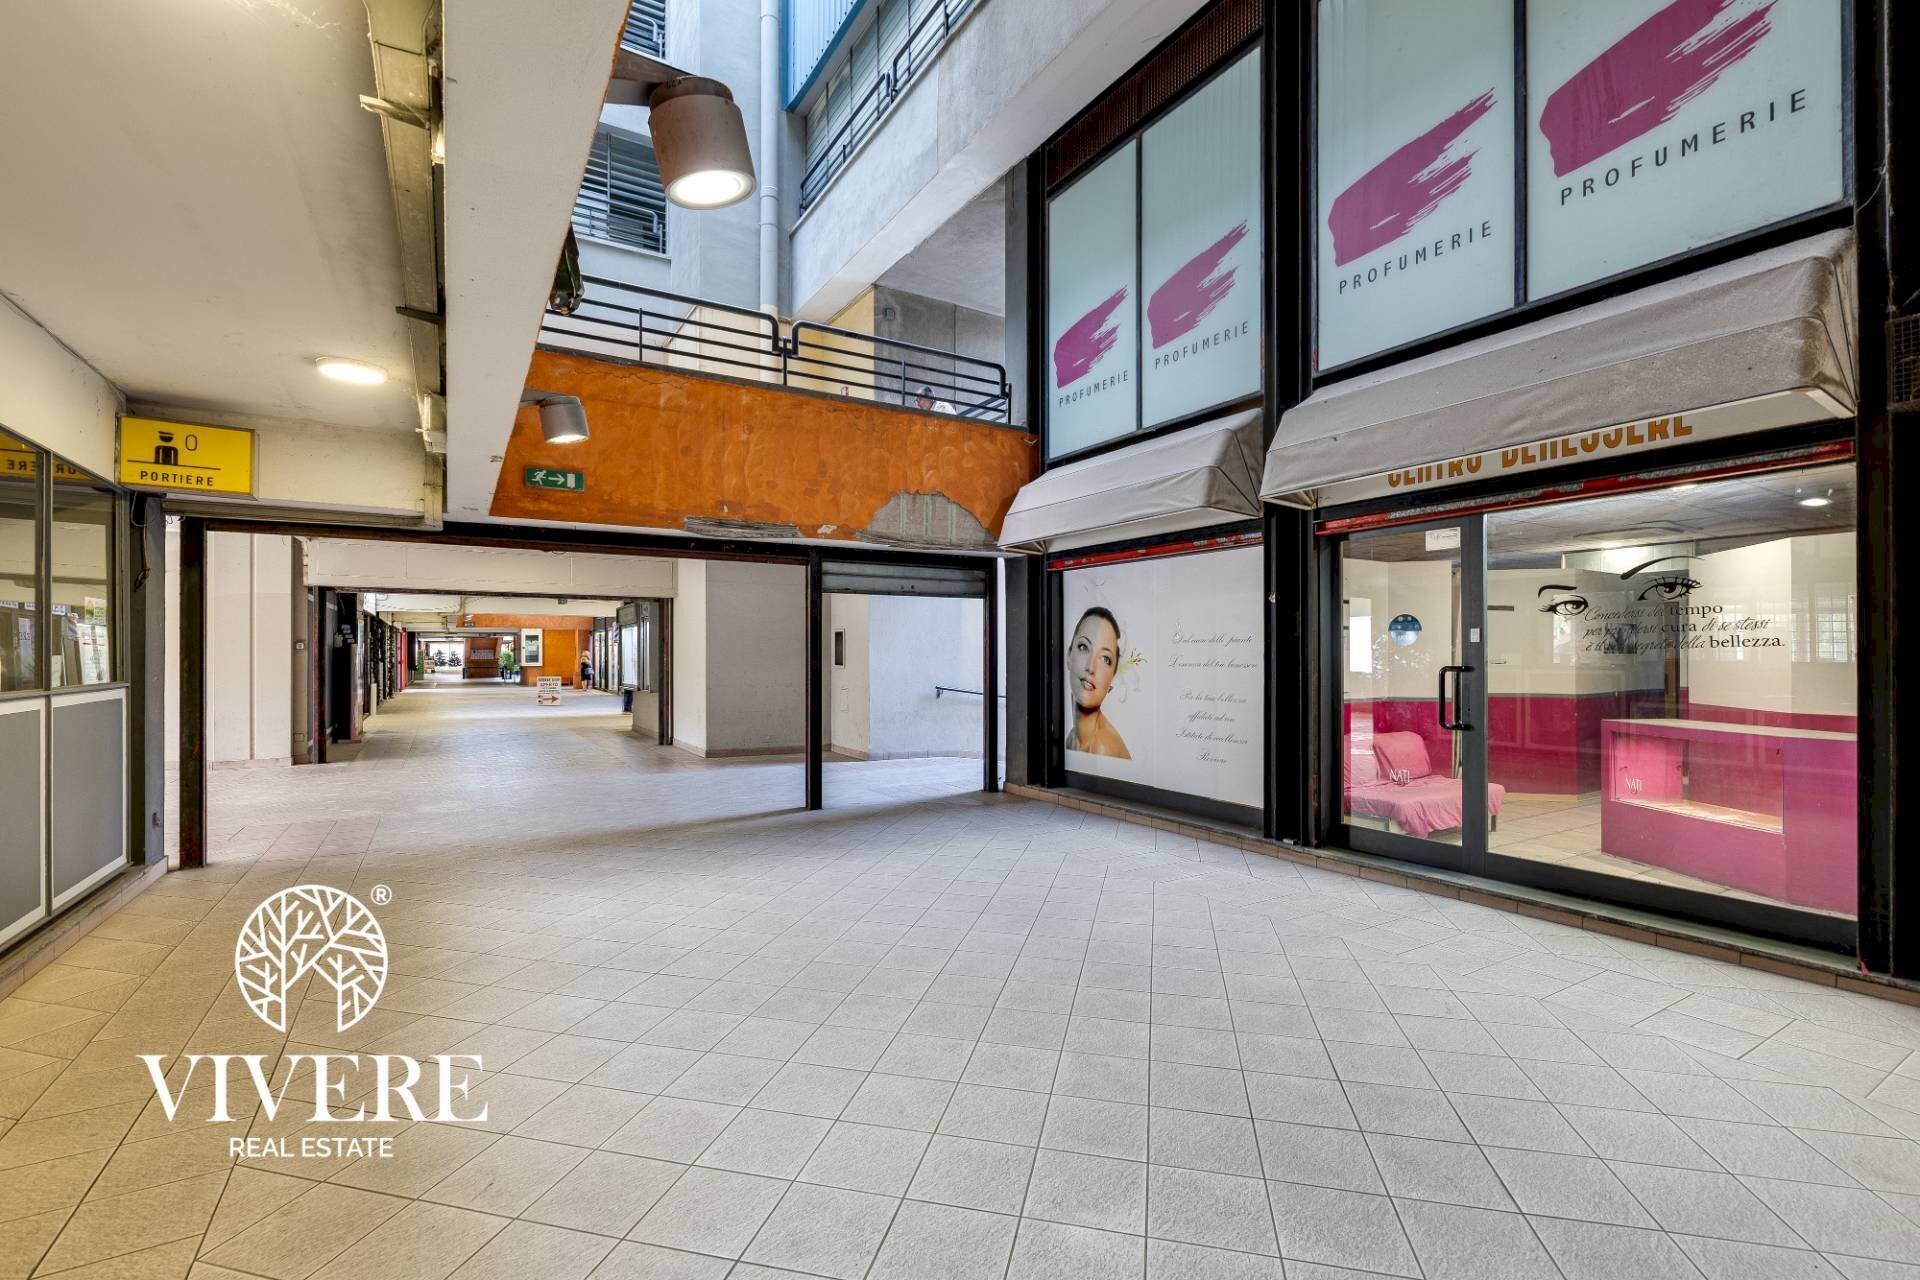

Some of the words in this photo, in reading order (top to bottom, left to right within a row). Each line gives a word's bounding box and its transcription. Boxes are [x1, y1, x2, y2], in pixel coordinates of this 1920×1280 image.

[1560, 88, 1807, 206] PROFUMERIE
[1338, 220, 1493, 296] PROFUMERIE
[1155, 320, 1250, 370] PROFUMERIE
[1058, 369, 1130, 408] PROFUMERIE
[139, 470, 215, 487] PORTIERE
[1661, 622, 1698, 633] cura
[1701, 617, 1716, 633] di
[1718, 621, 1732, 632] se
[1733, 616, 1772, 631] stessi
[1670, 604, 1724, 619] tempo
[1709, 634, 1786, 649] bellezza.
